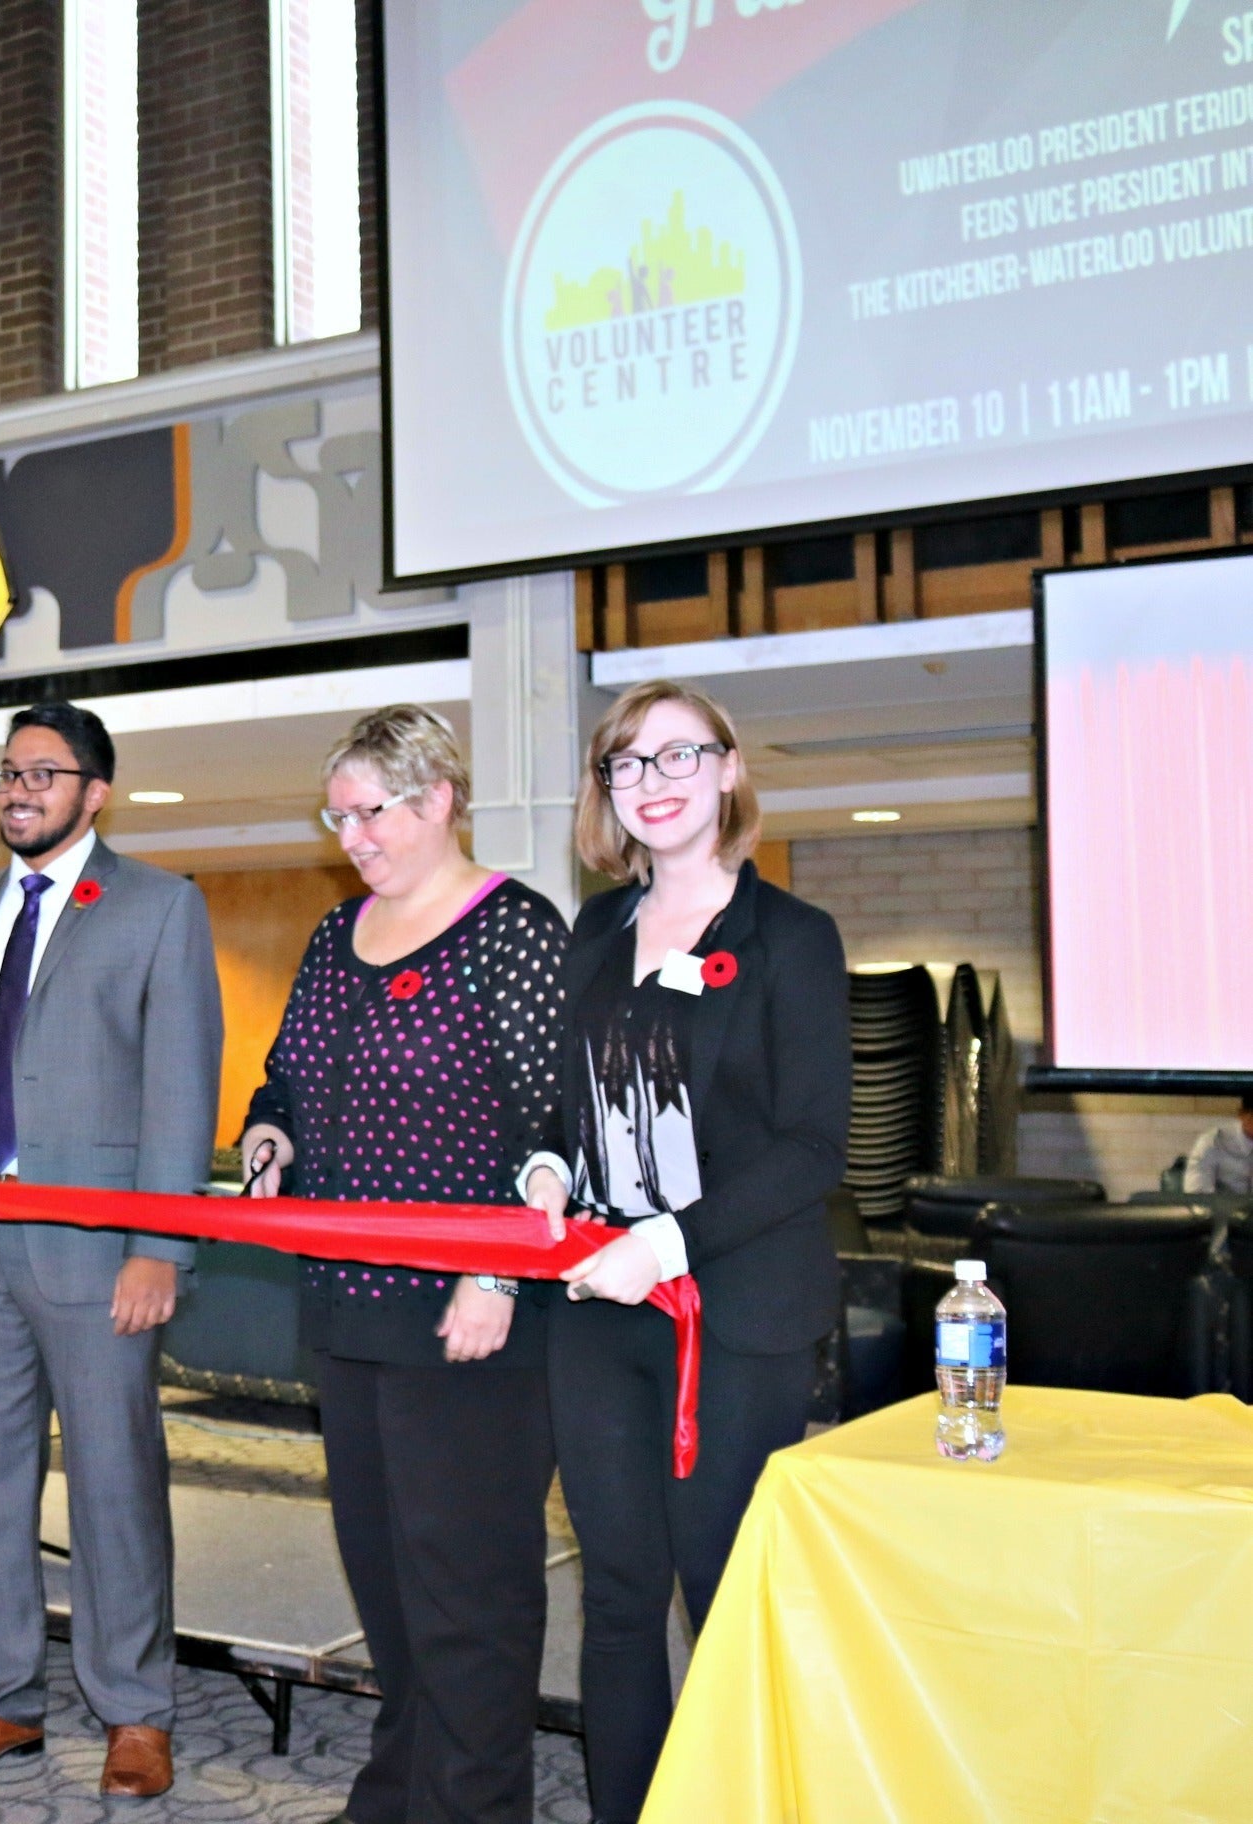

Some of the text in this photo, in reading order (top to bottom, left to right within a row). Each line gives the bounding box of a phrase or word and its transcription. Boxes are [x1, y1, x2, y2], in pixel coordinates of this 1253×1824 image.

[900, 134, 1033, 195] UWATERLOO
[1039, 102, 1169, 167] PRESIDENT
[961, 195, 1018, 242] FEDS
[1023, 180, 1077, 230] VICE
[1080, 155, 1215, 219] PRESIDENT
[849, 278, 890, 321] THE
[895, 228, 1154, 312] KITCHENER-WATERLOO
[545, 299, 746, 372] VOLUNTEER
[546, 342, 748, 414] CENTRE
[808, 398, 960, 464] NOVEMBER
[971, 390, 1006, 438] 10
[1049, 369, 1132, 428] 11AM
[1163, 353, 1229, 410] 1PM
